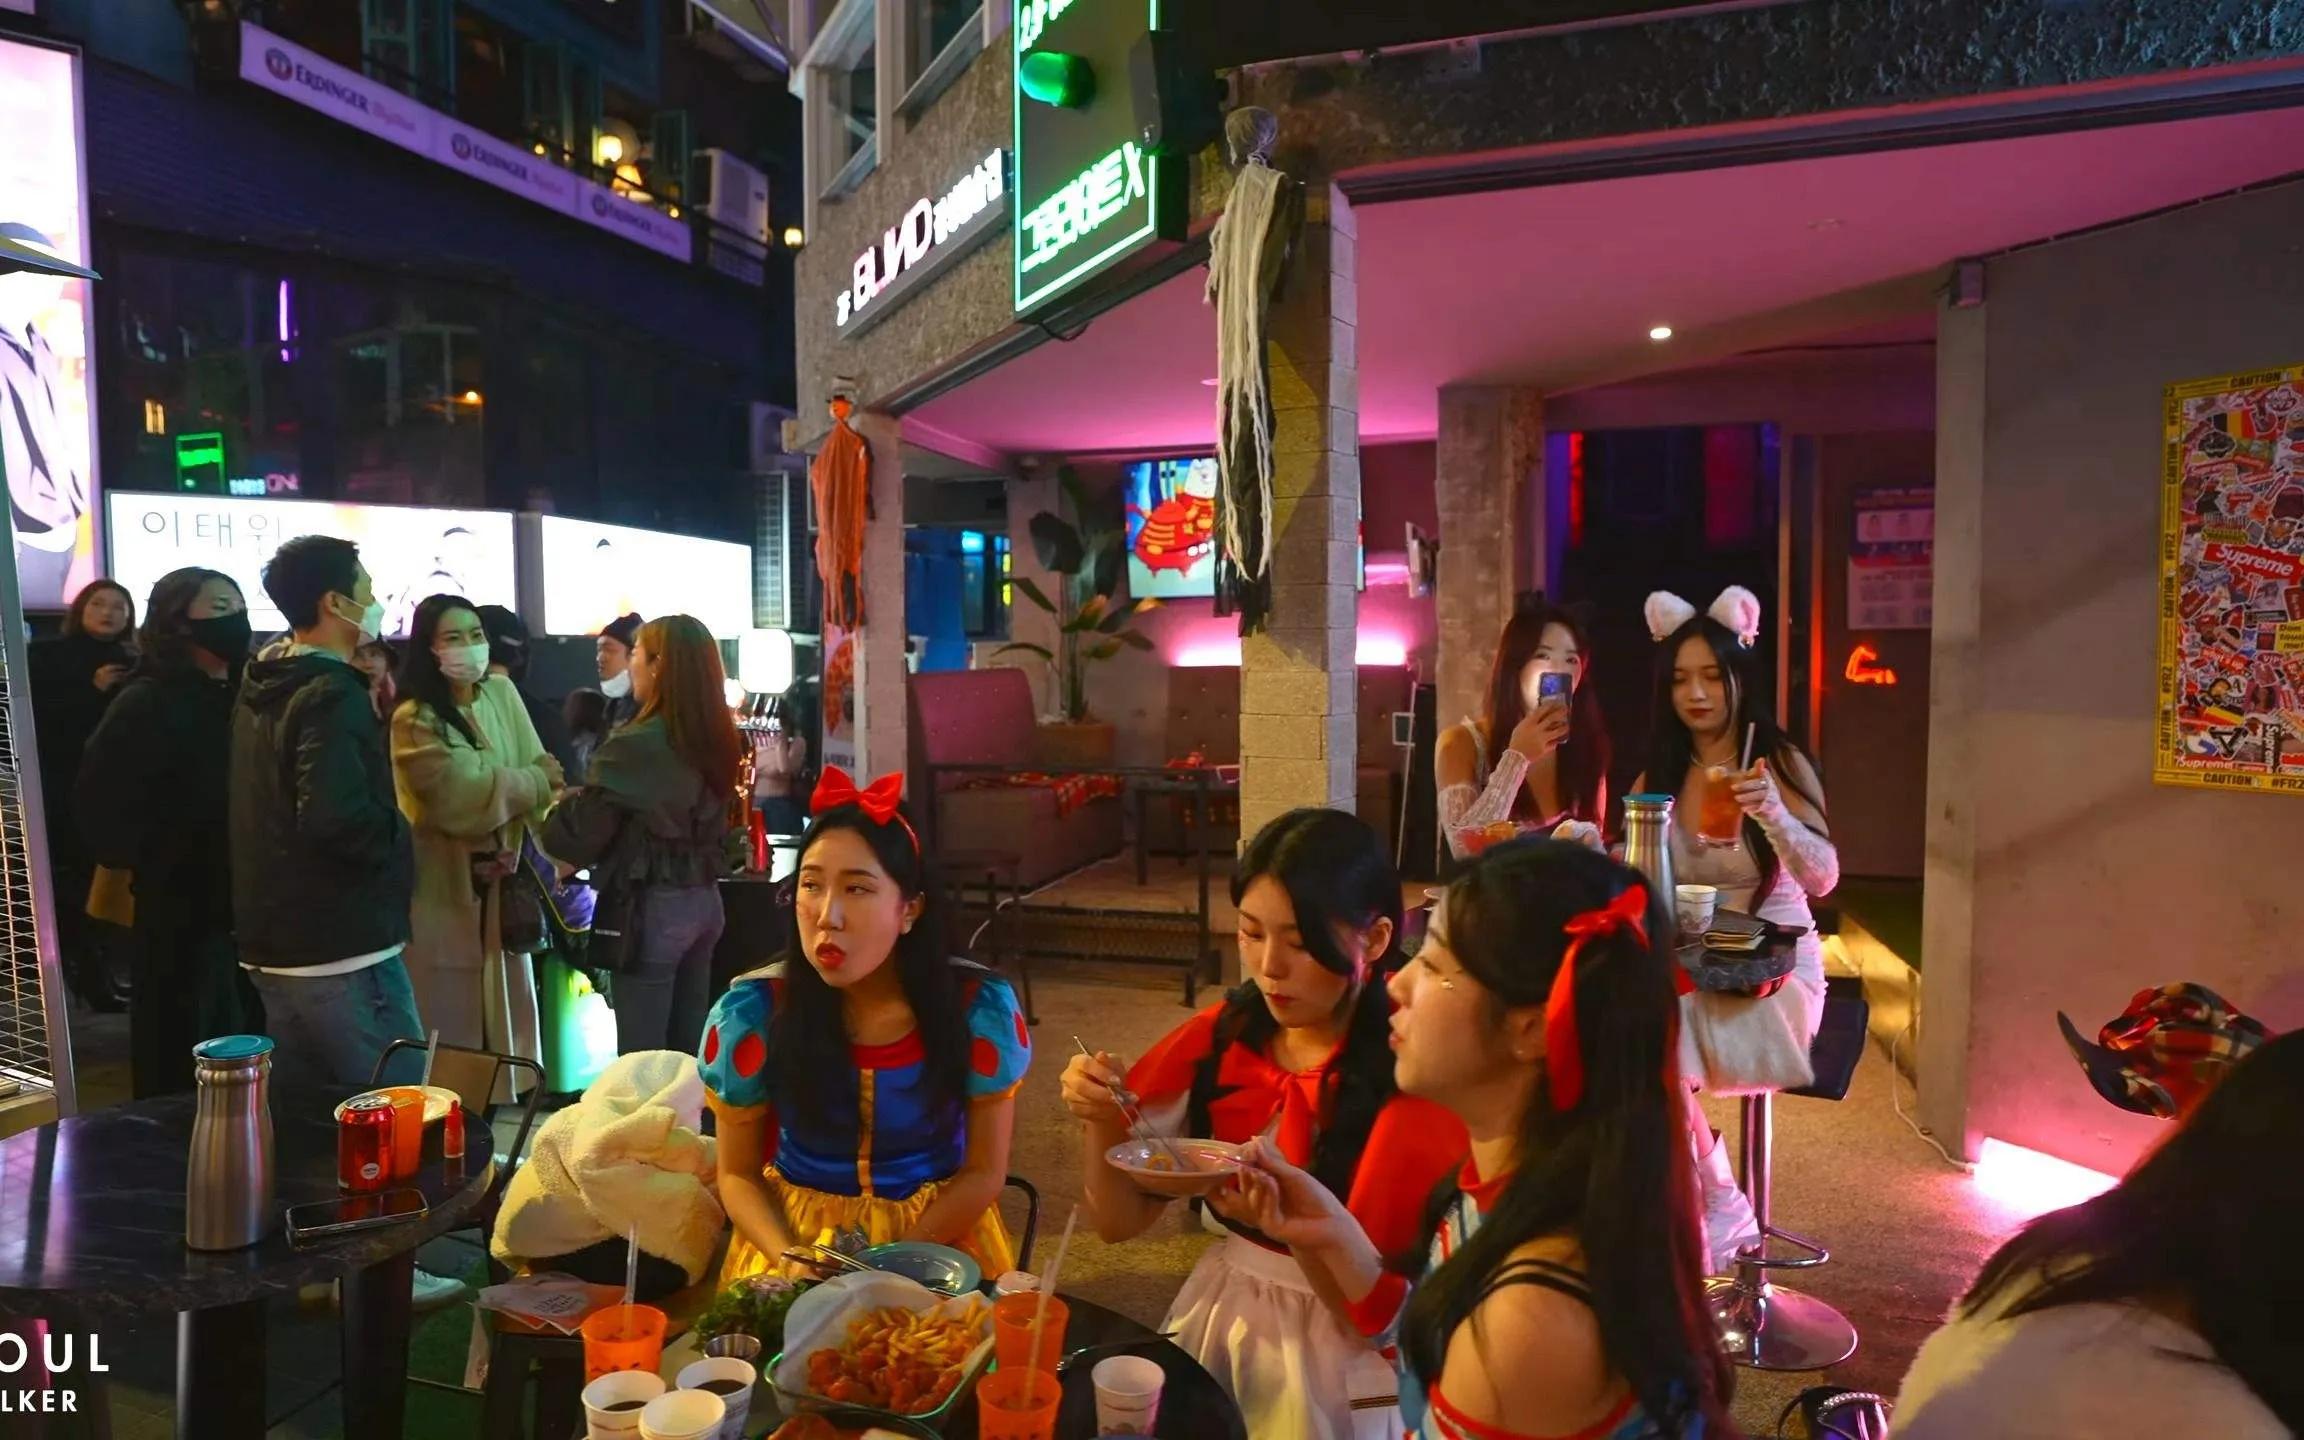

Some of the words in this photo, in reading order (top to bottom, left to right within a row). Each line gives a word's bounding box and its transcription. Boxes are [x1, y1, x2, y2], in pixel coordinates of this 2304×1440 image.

[296, 64, 370, 115] ERDINGER
[474, 146, 528, 181] ERDINGER
[2230, 373, 2281, 388] CAUTION
[2165, 443, 2179, 485] CAUTION
[2216, 544, 2294, 576] Supreme
[2163, 576, 2175, 618] CAUTION
[2159, 709, 2172, 752] CAUTION
[2203, 772, 2252, 786] CAUTION
